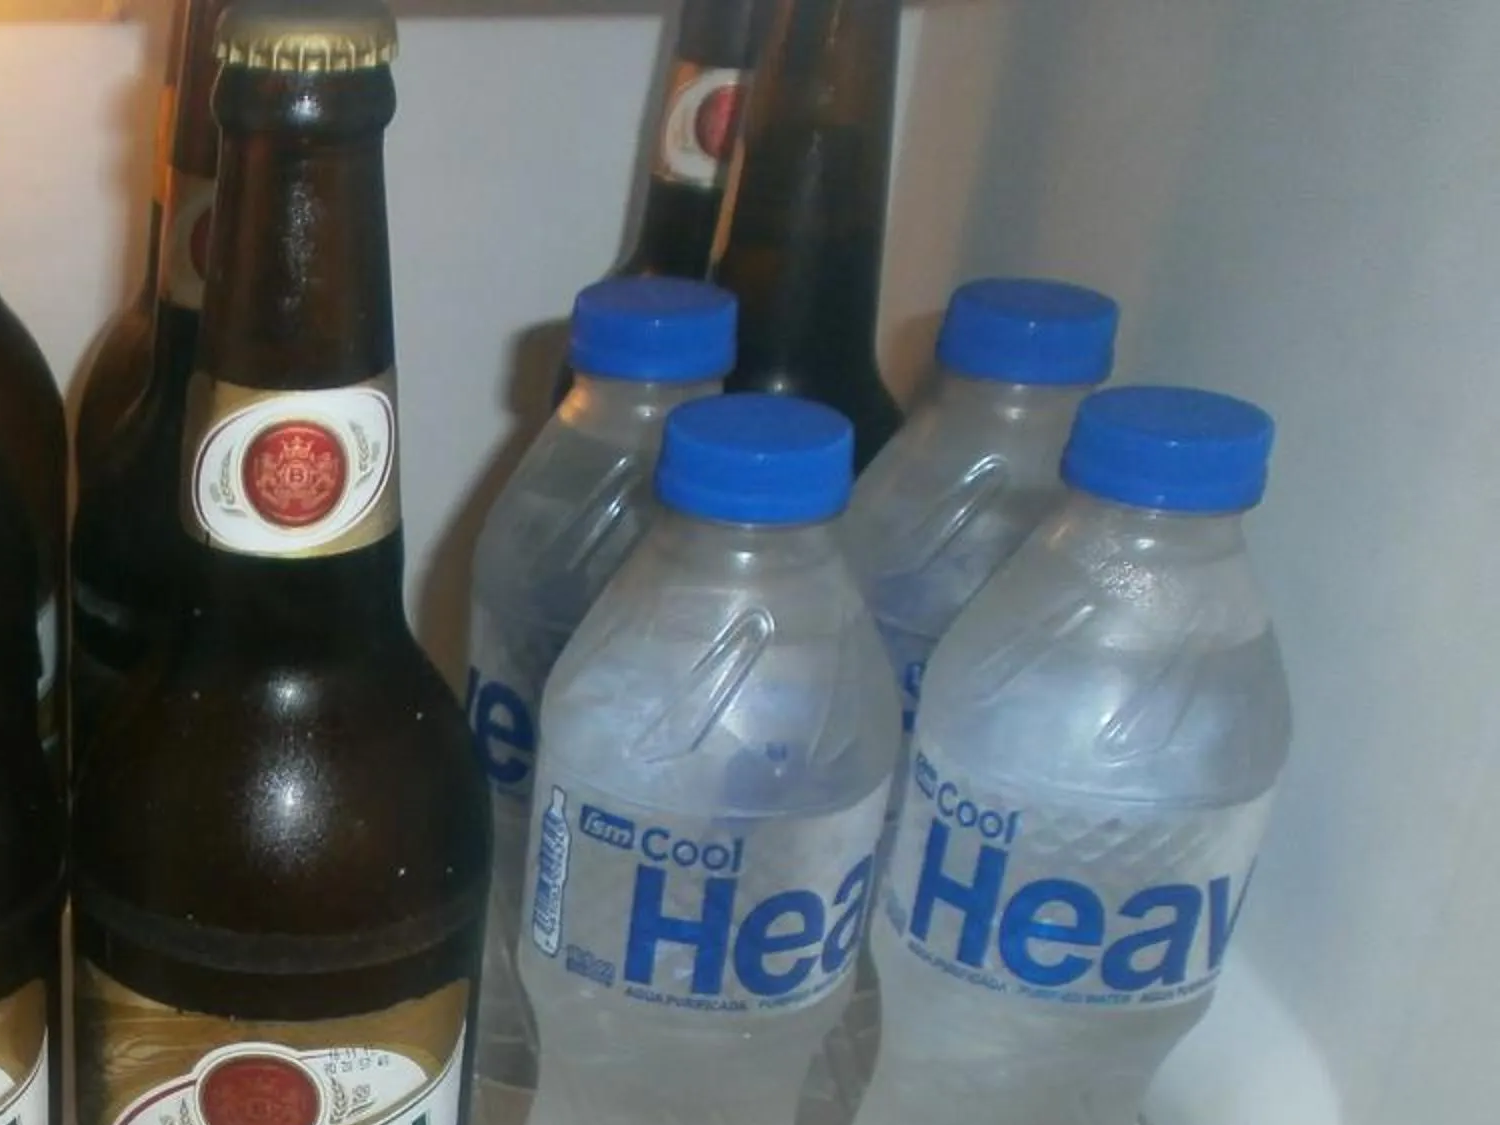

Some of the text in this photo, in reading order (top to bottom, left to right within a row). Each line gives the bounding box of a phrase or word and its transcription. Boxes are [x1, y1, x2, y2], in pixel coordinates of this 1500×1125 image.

[467, 666, 536, 783] e
[936, 783, 1021, 843] Cool
[641, 826, 744, 872] Cool
